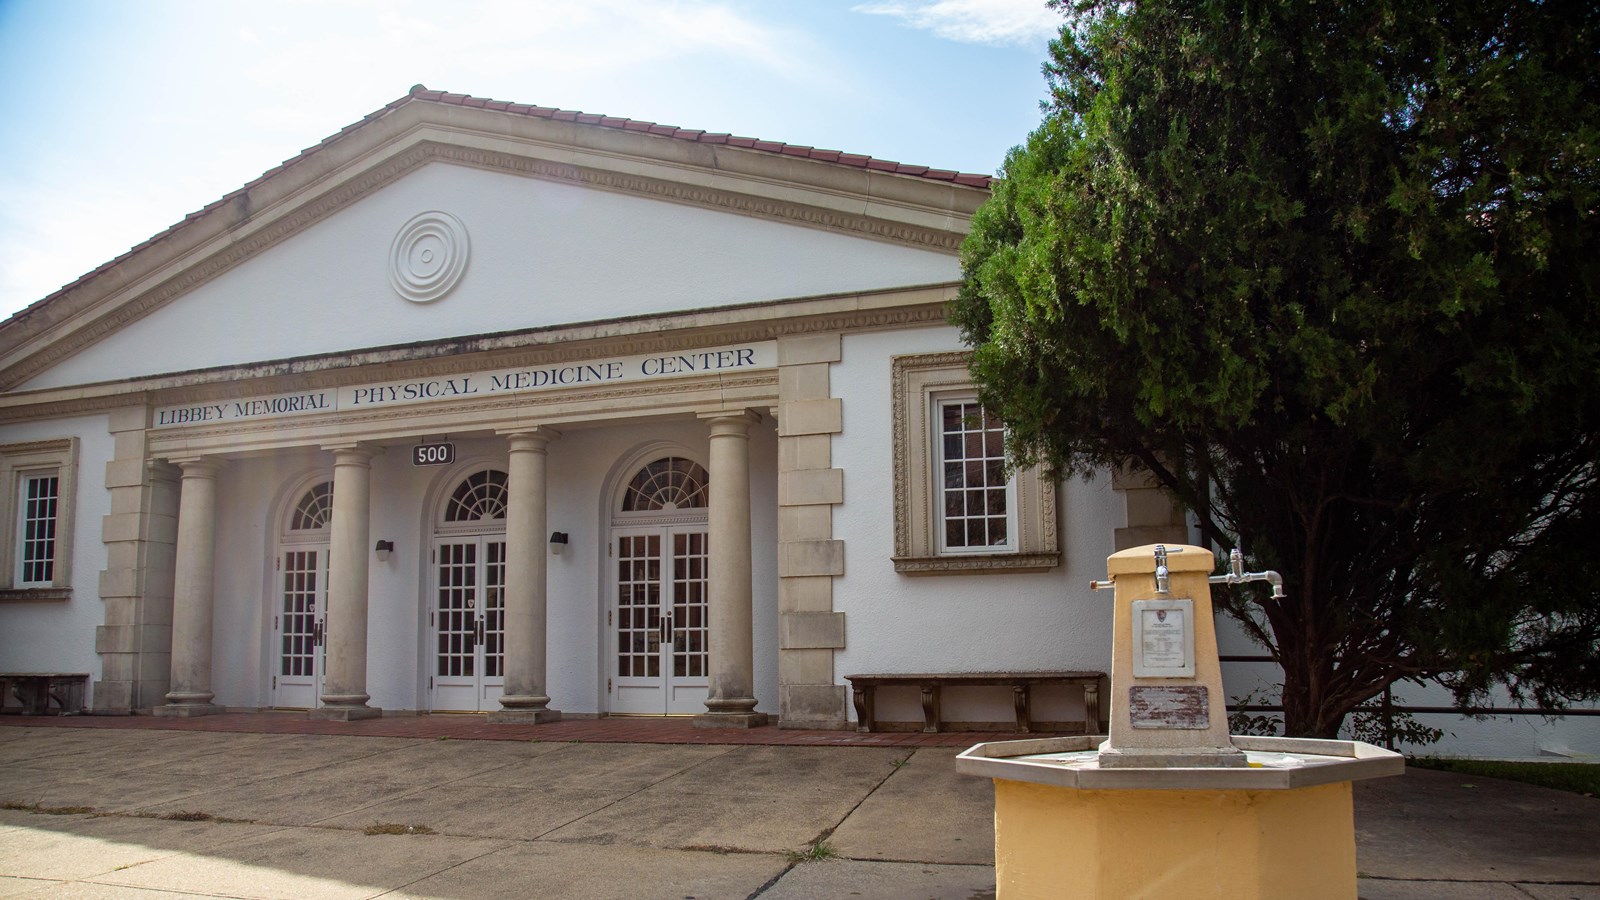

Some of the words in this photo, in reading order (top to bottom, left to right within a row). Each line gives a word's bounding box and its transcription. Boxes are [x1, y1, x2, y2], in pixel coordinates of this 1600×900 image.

[160, 404, 228, 425] LIBBEY
[235, 393, 329, 417] MEMORIAL
[353, 378, 478, 404] PHYSICAL
[491, 362, 623, 391] MEDICINE
[641, 348, 756, 374] CENTER
[418, 446, 447, 463] 500
